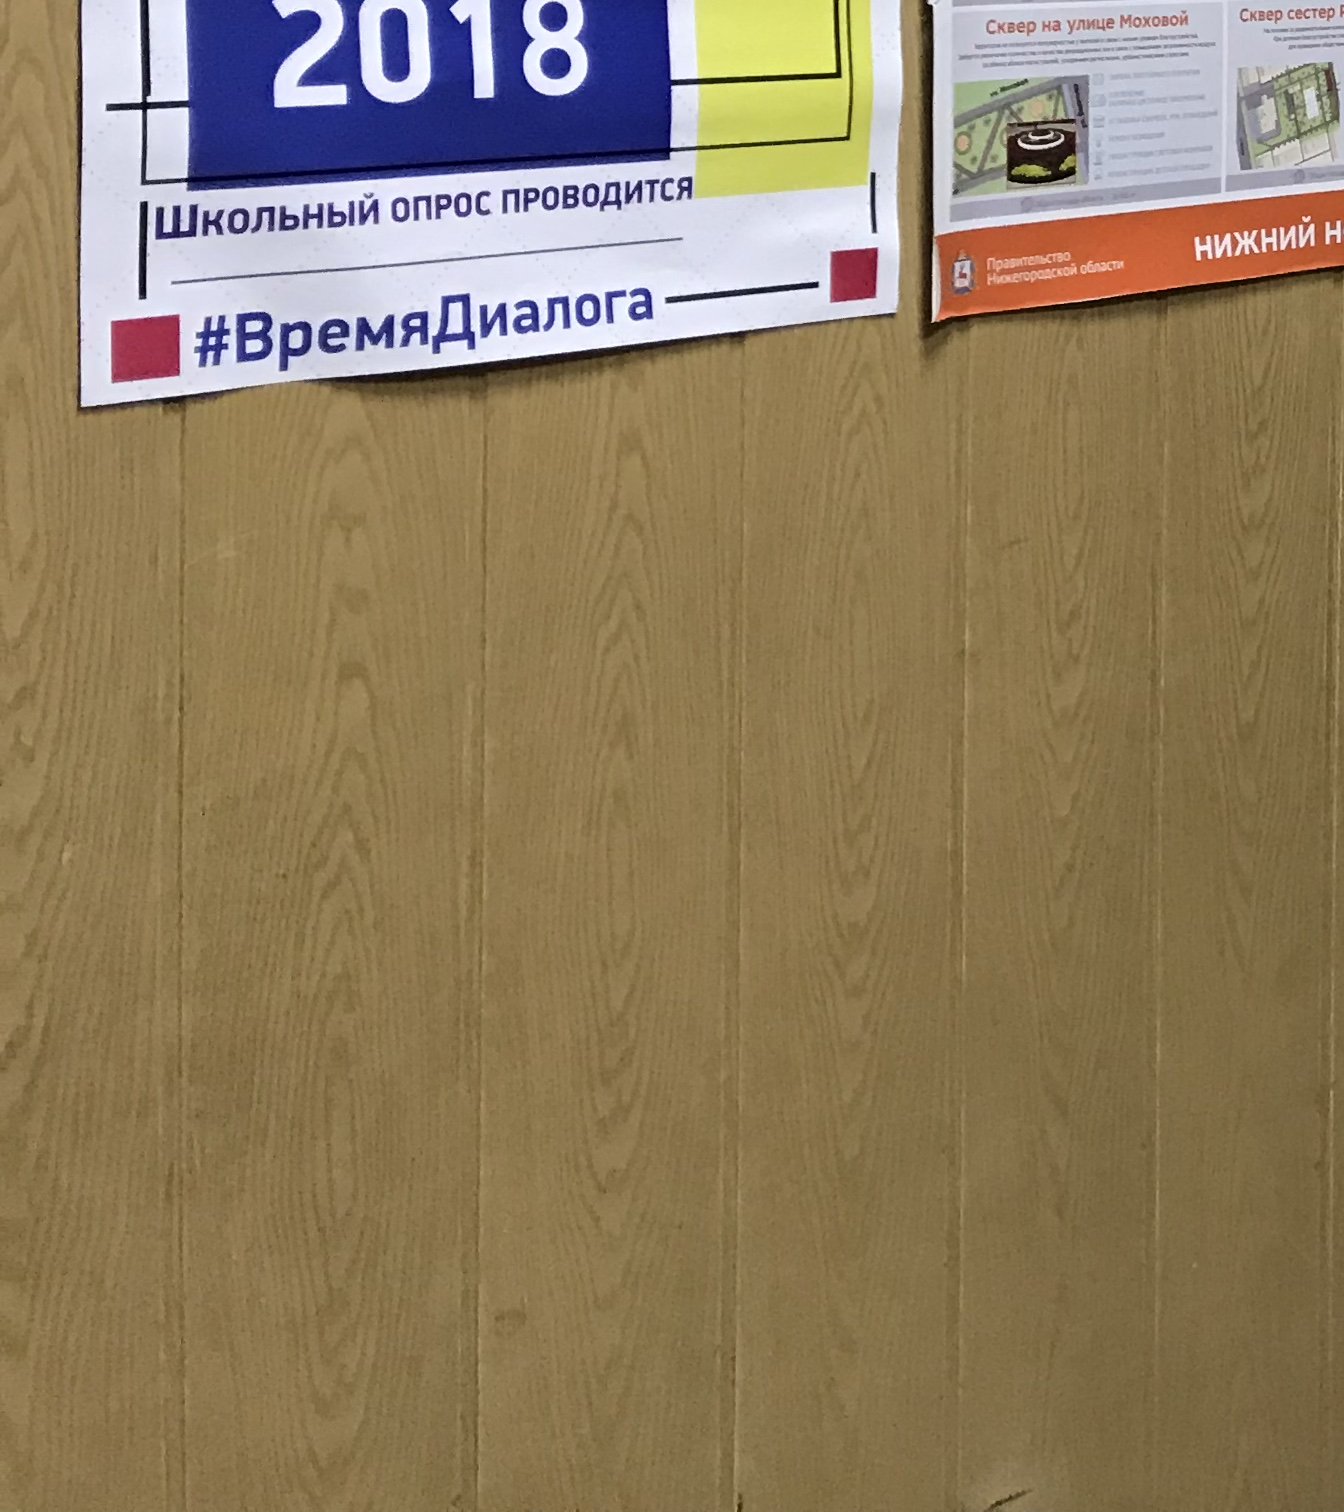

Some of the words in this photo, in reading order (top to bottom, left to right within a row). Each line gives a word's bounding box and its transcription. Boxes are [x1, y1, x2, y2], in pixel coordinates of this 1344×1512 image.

[986, 19, 1036, 36] Сквер
[1042, 18, 1061, 31] на
[1066, 16, 1115, 34] улице
[1119, 10, 1189, 28] Моховой
[1239, 8, 1283, 23] Сквер
[1287, 6, 1335, 20] сестер
[1194, 216, 1316, 261] НИЖНИЙ
[987, 251, 1070, 270] Правительство
[987, 264, 1077, 285] Нижегородской
[1080, 259, 1124, 274] области
[194, 283, 655, 372] #ВремяДиалога
